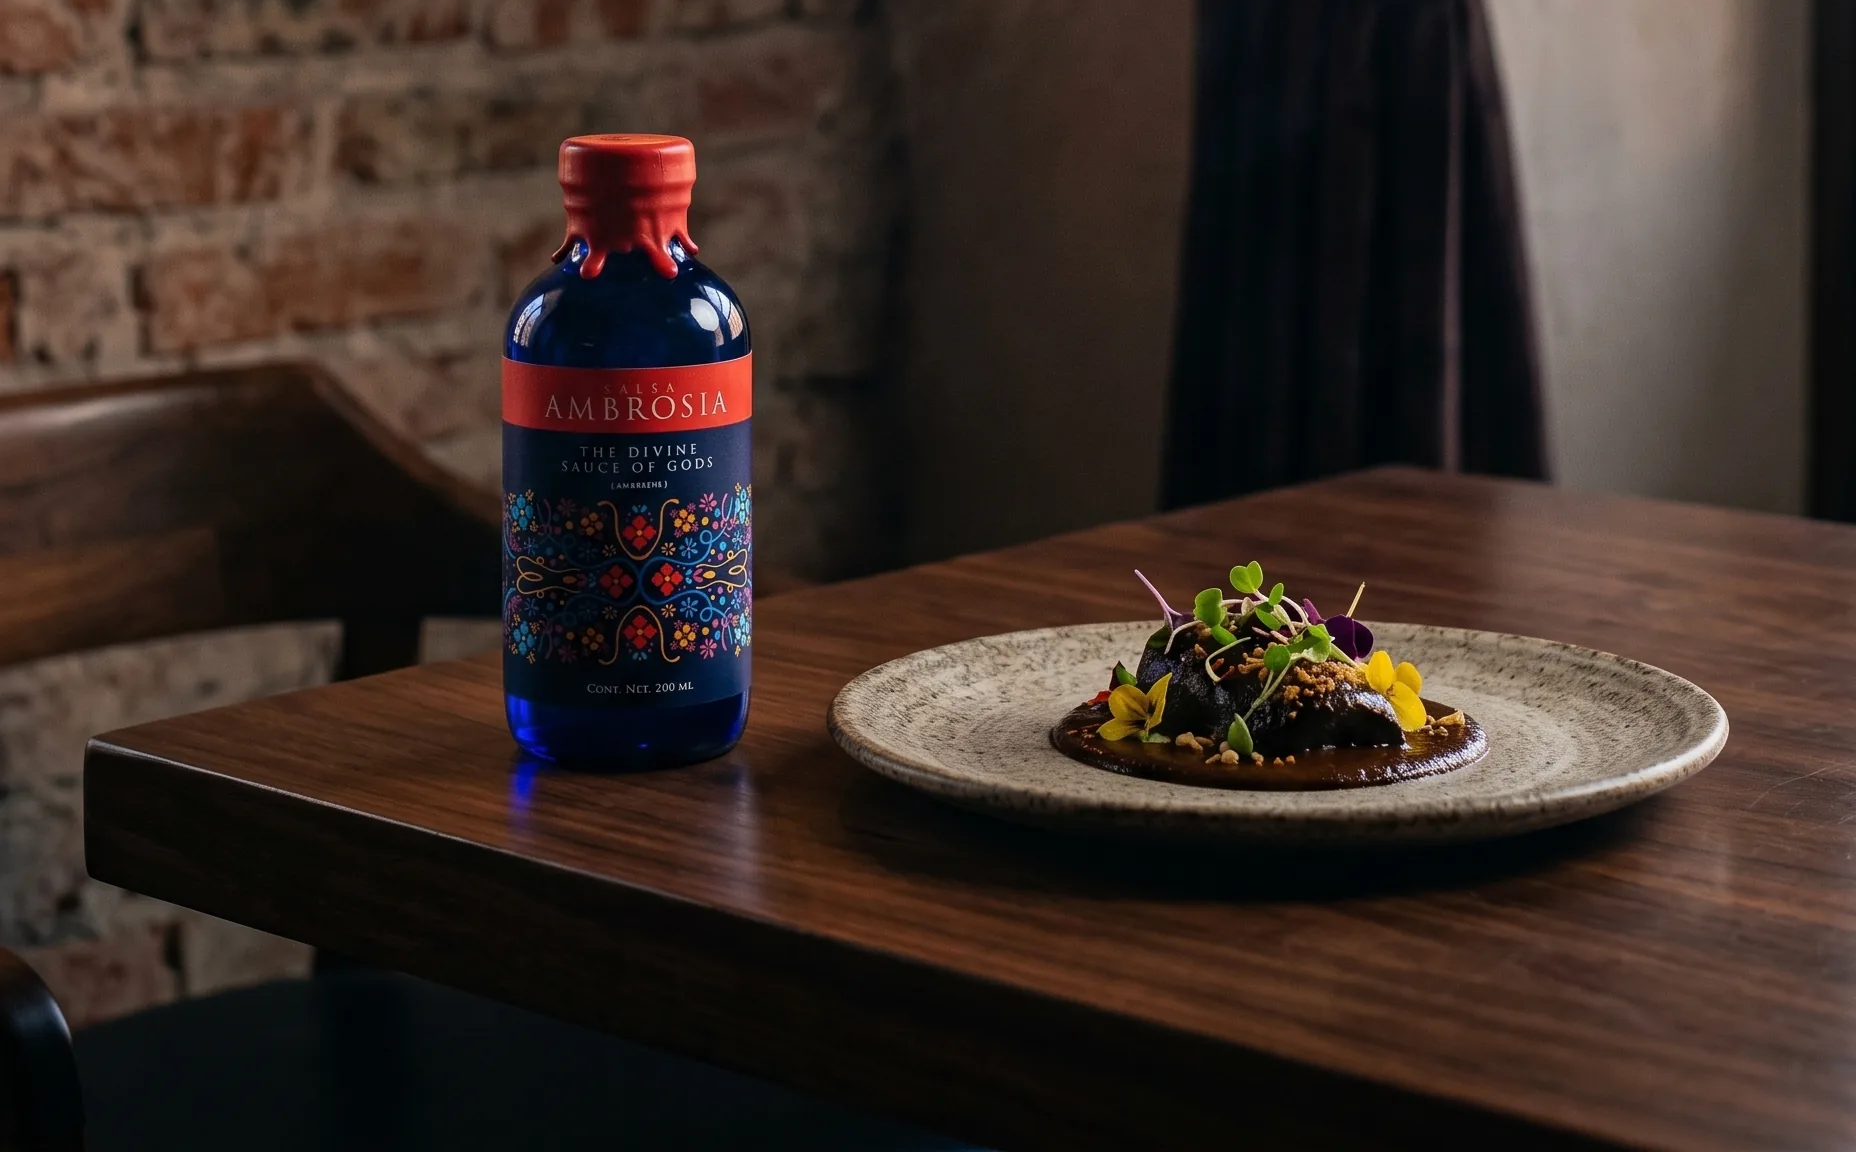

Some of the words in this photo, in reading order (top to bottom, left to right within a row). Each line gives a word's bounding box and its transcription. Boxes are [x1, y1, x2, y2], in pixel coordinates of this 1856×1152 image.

[604, 382, 675, 395] SALSA
[545, 390, 727, 421] AMBROSIA
[580, 446, 616, 458] THE
[628, 443, 697, 458] DIVINE
[561, 460, 620, 474] SAUCE
[631, 461, 656, 474] OF
[666, 456, 714, 472] GODS
[655, 682, 676, 693] 200
